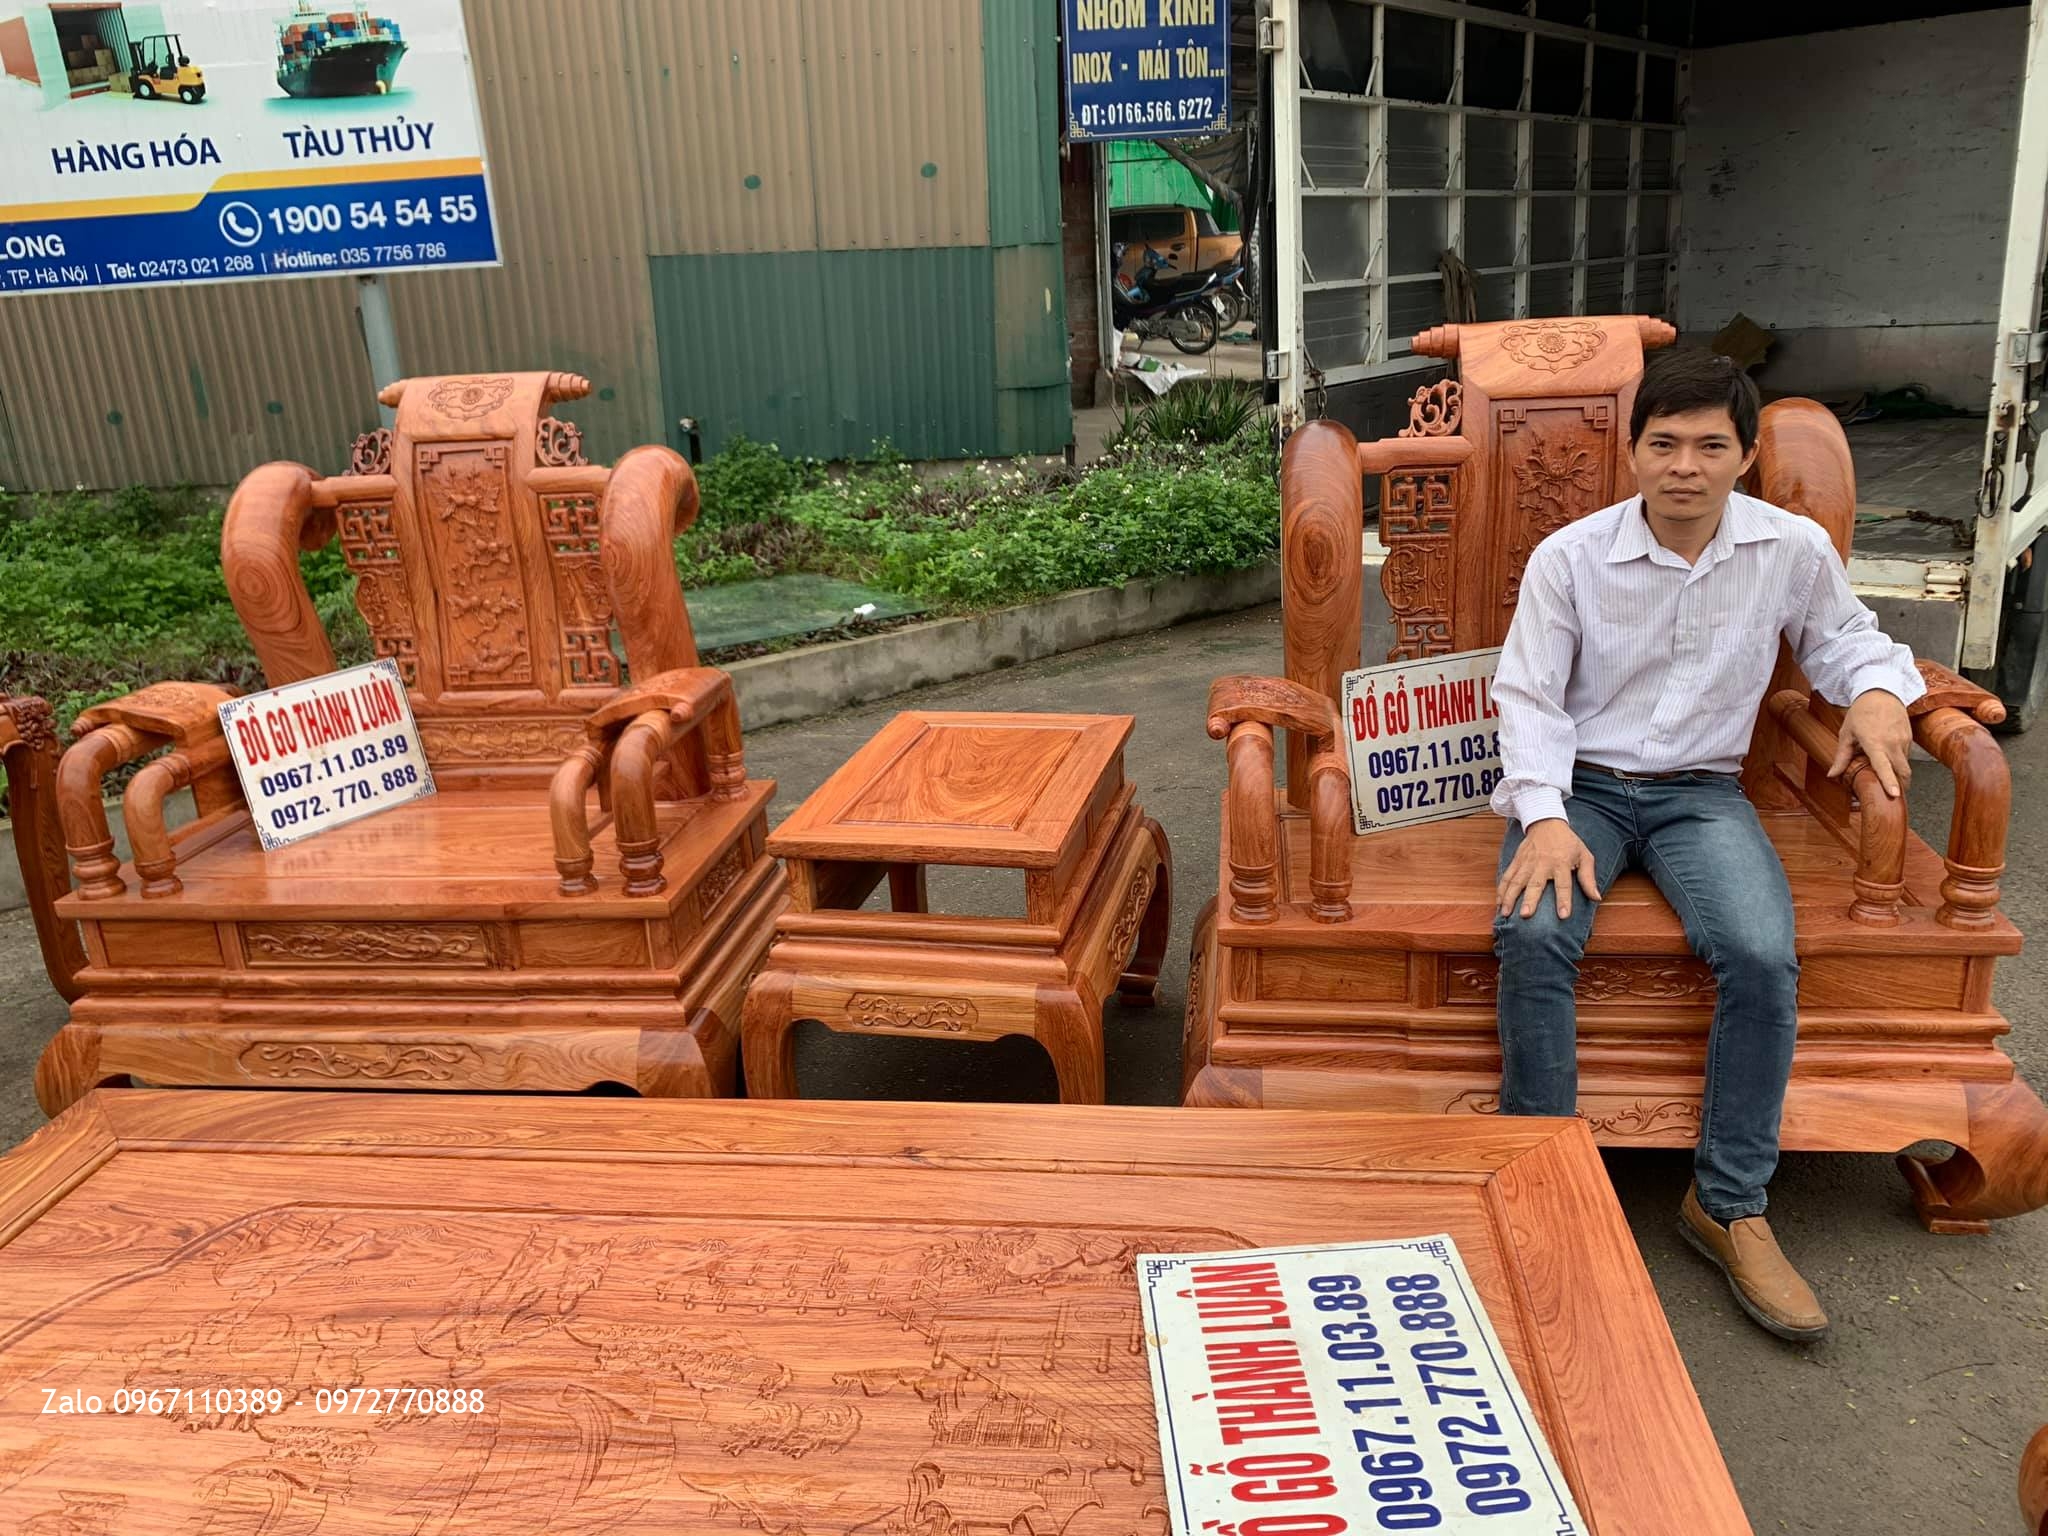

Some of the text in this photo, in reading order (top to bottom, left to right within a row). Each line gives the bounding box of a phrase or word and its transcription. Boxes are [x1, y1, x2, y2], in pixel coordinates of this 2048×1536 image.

[1072, 52, 1112, 84] INOX
[1138, 40, 1170, 81] MÁI
[52, 132, 221, 174] HÀNG HÓA
[283, 116, 434, 158] TÀU THỦY
[269, 195, 477, 235] 1900 54 54 55
[7, 269, 32, 286] TP.
[35, 267, 59, 285] Hà
[61, 265, 88, 285] Nội
[107, 255, 254, 280] Tel: 02473 021 268
[274, 242, 447, 270] Hotline: 035 7756 786
[236, 701, 270, 766] ĐỒ
[292, 688, 357, 749] THÀNH
[352, 672, 402, 732] LUÂN
[1352, 680, 1379, 742] ĐỒ
[1384, 674, 1410, 737] GỖ
[1414, 674, 1477, 730] THÀNH
[260, 734, 409, 798] 0967.11.03.89
[1177, 1262, 1292, 1334] LUÂN
[1191, 1339, 1321, 1445] THÀNH
[1307, 1274, 1443, 1530] 0967.11.03.89
[1385, 1273, 1532, 1517] 0972.770.888
[1188, 1452, 1338, 1503] GỖ
